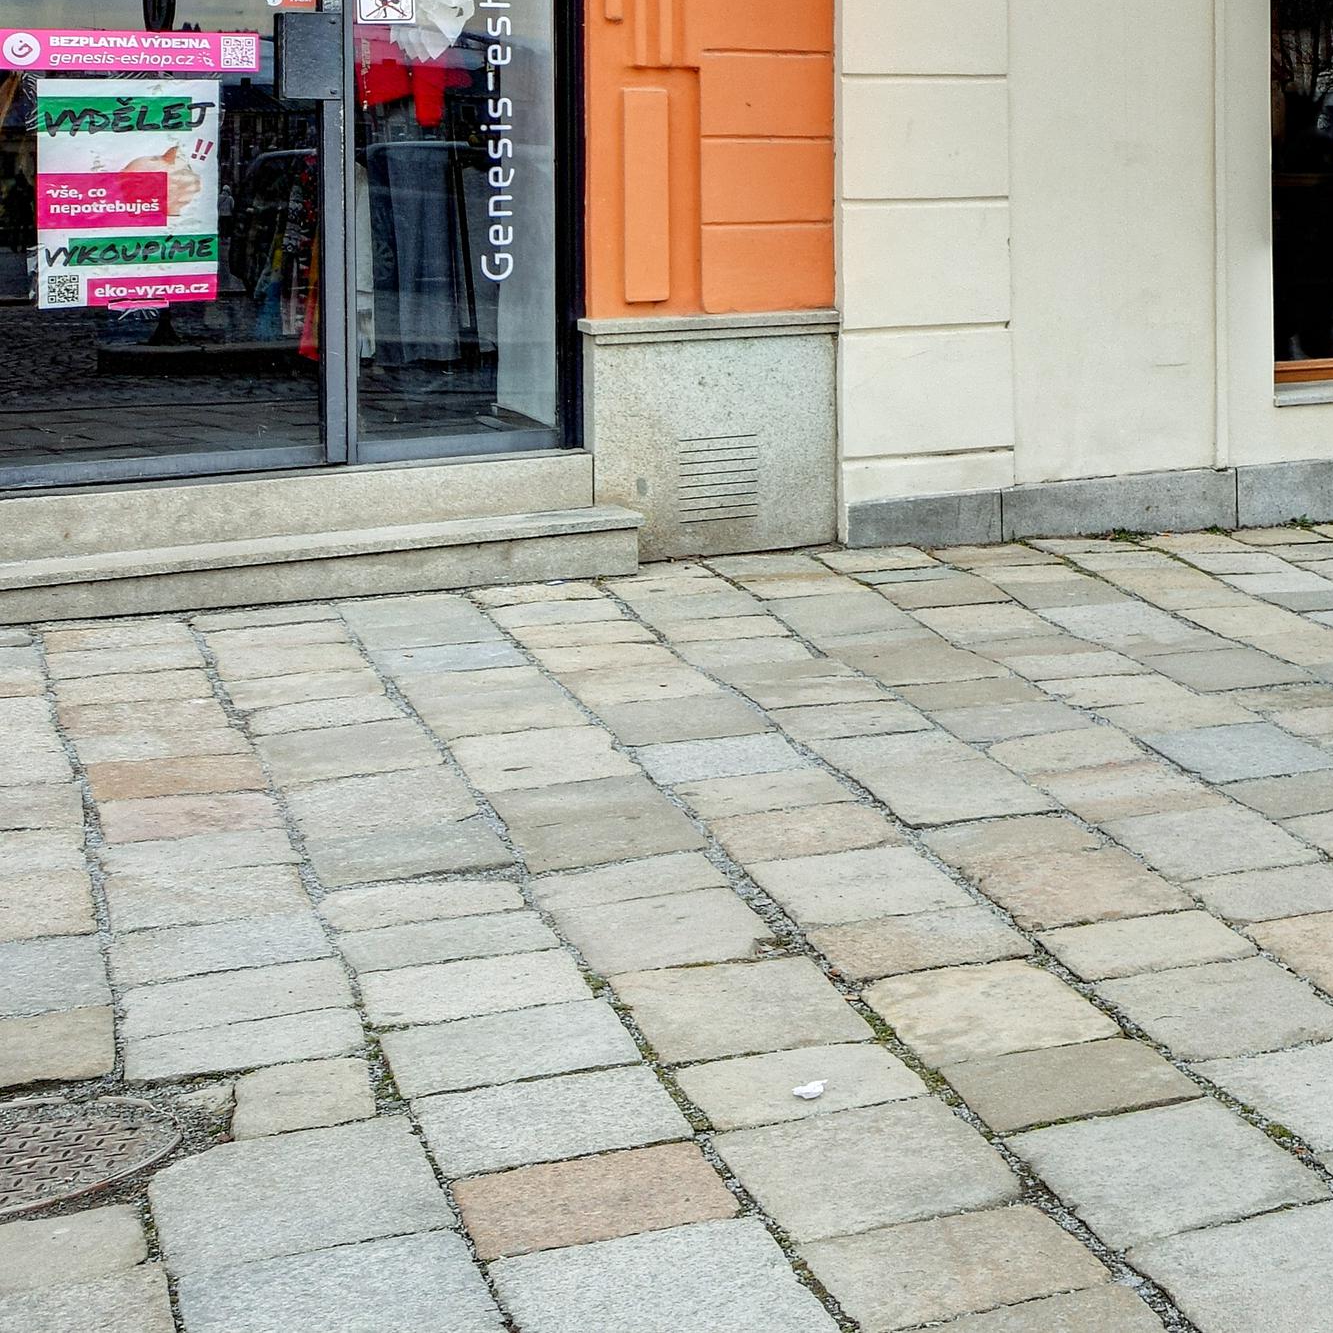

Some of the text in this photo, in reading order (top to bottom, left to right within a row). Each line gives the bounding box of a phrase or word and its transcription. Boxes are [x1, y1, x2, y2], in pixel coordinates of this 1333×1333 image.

[49, 35, 211, 49] BEZPLATNÁ VÝDEJNA
[50, 51, 195, 66] genesis-eshop.cz
[44, 97, 216, 137] VYDĚLEJ
[50, 185, 107, 200] vše, co
[50, 199, 160, 215] nepotřebuješ
[44, 235, 214, 267] VYKOUPÍME
[94, 282, 209, 299] eko-vyzva.cz
